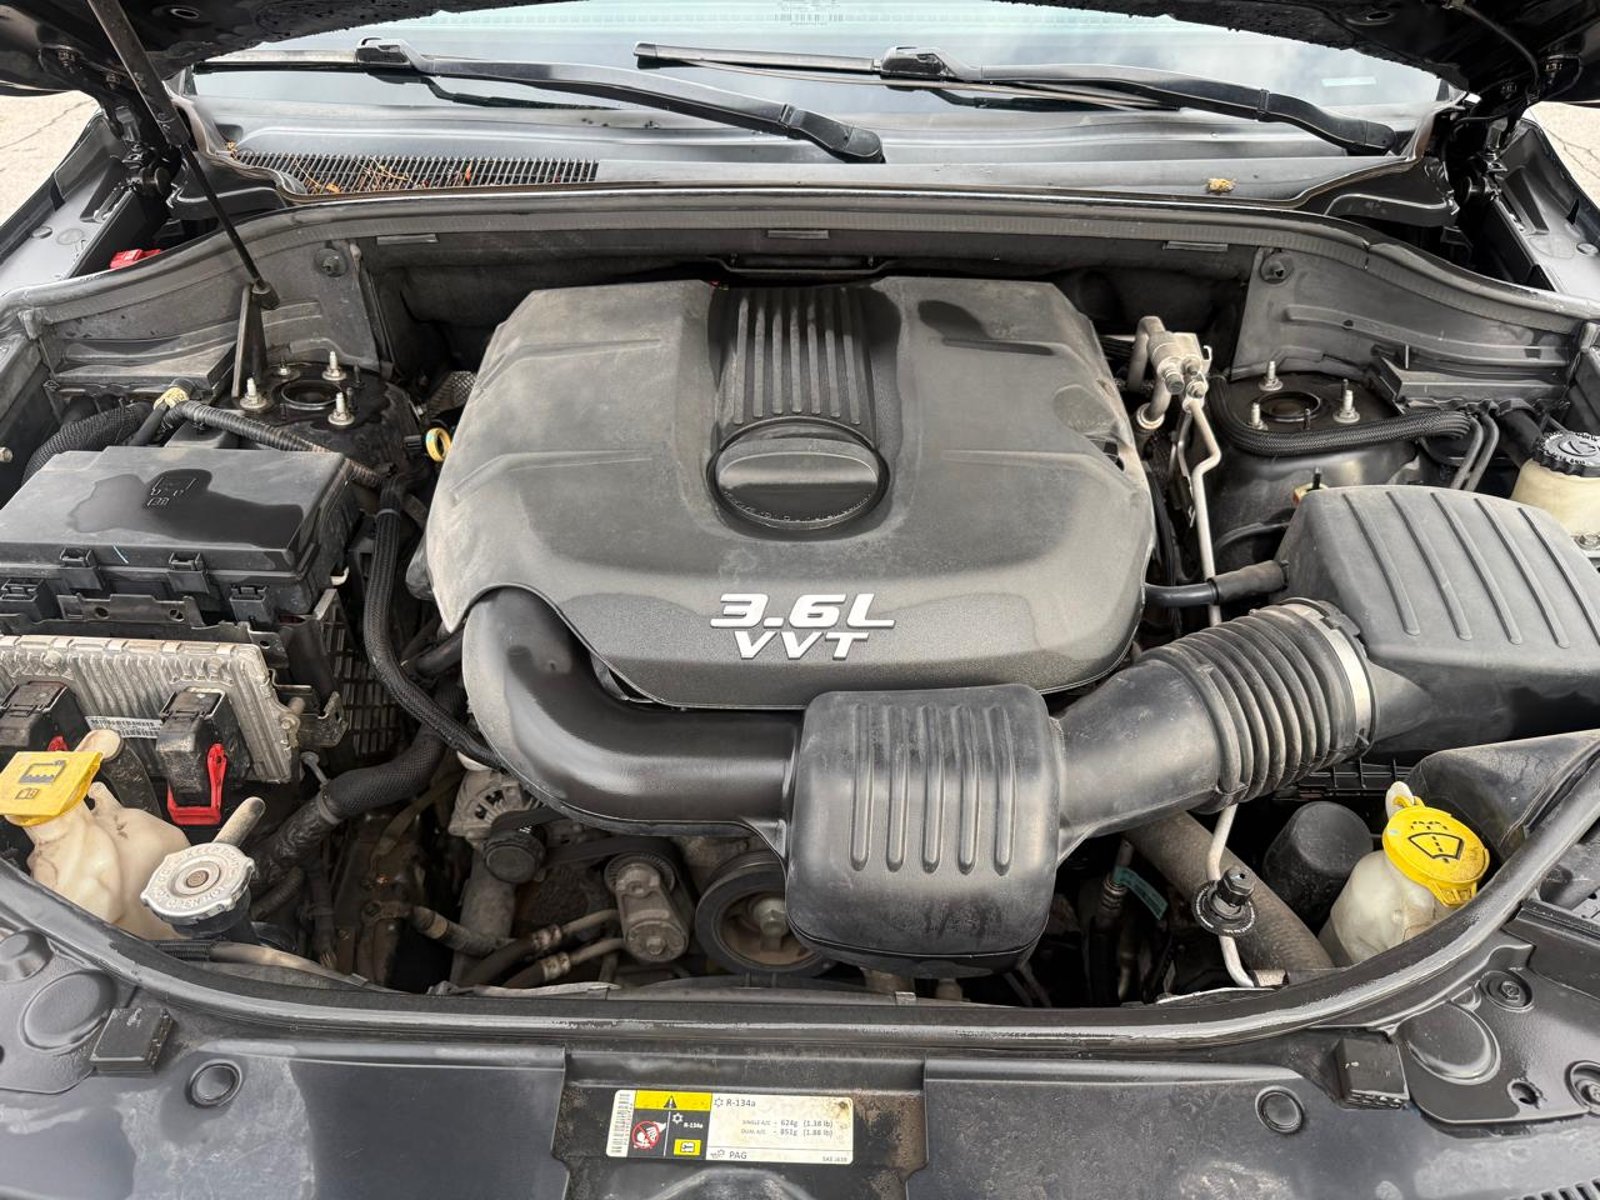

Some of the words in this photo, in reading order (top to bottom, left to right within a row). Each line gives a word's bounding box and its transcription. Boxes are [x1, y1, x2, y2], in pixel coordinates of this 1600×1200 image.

[709, 593, 896, 629] 3.6L
[734, 630, 869, 661] VVT
[725, 1098, 756, 1107] R-134a
[729, 1150, 747, 1160] PAG
